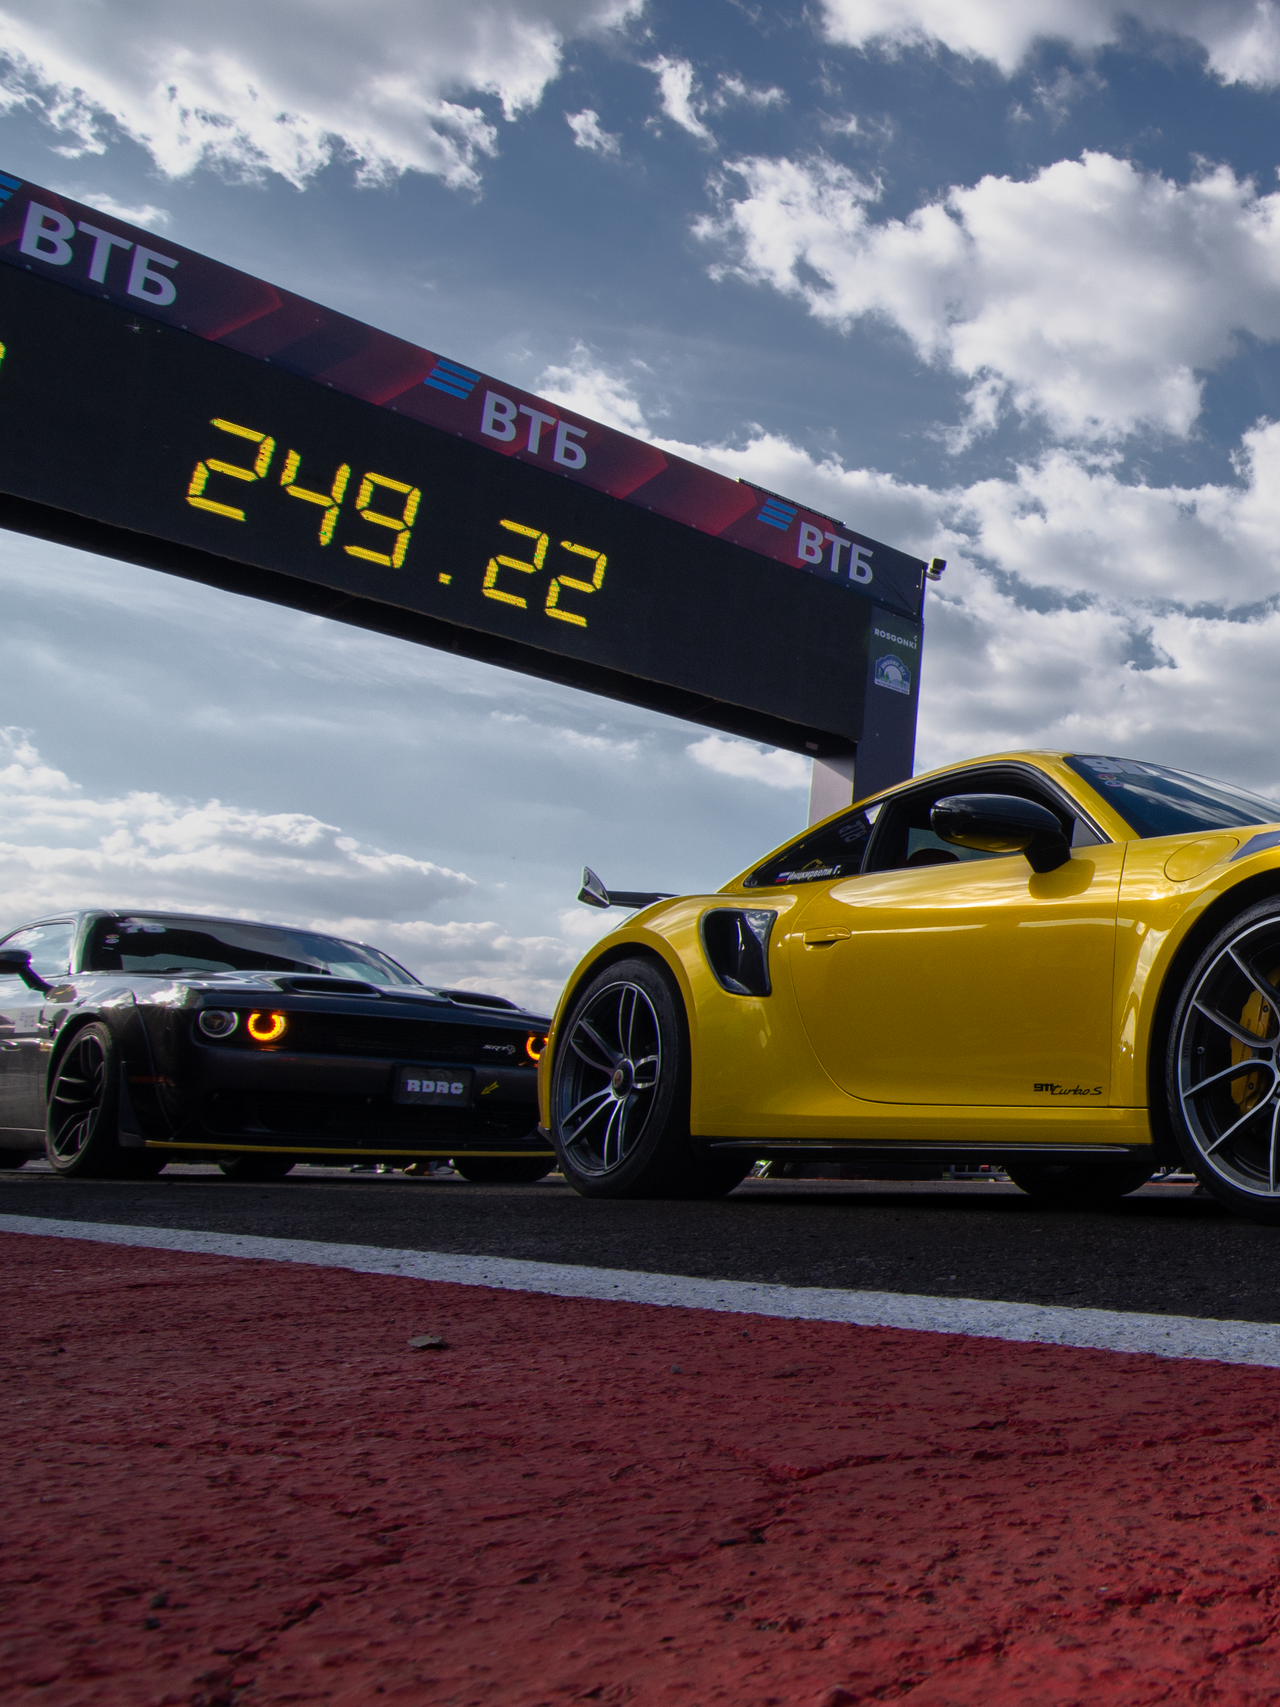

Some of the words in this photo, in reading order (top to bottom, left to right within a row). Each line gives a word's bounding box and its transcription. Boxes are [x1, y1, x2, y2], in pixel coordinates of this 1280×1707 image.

[19, 200, 179, 306] ВТБ
[480, 391, 588, 470] ВТБ
[185, 418, 607, 627] 249.22
[797, 521, 874, 585] ВТБ
[874, 628, 917, 649] ROSGONKI
[406, 1079, 464, 1095] RDRC
[1033, 1083, 1054, 1092] 911
